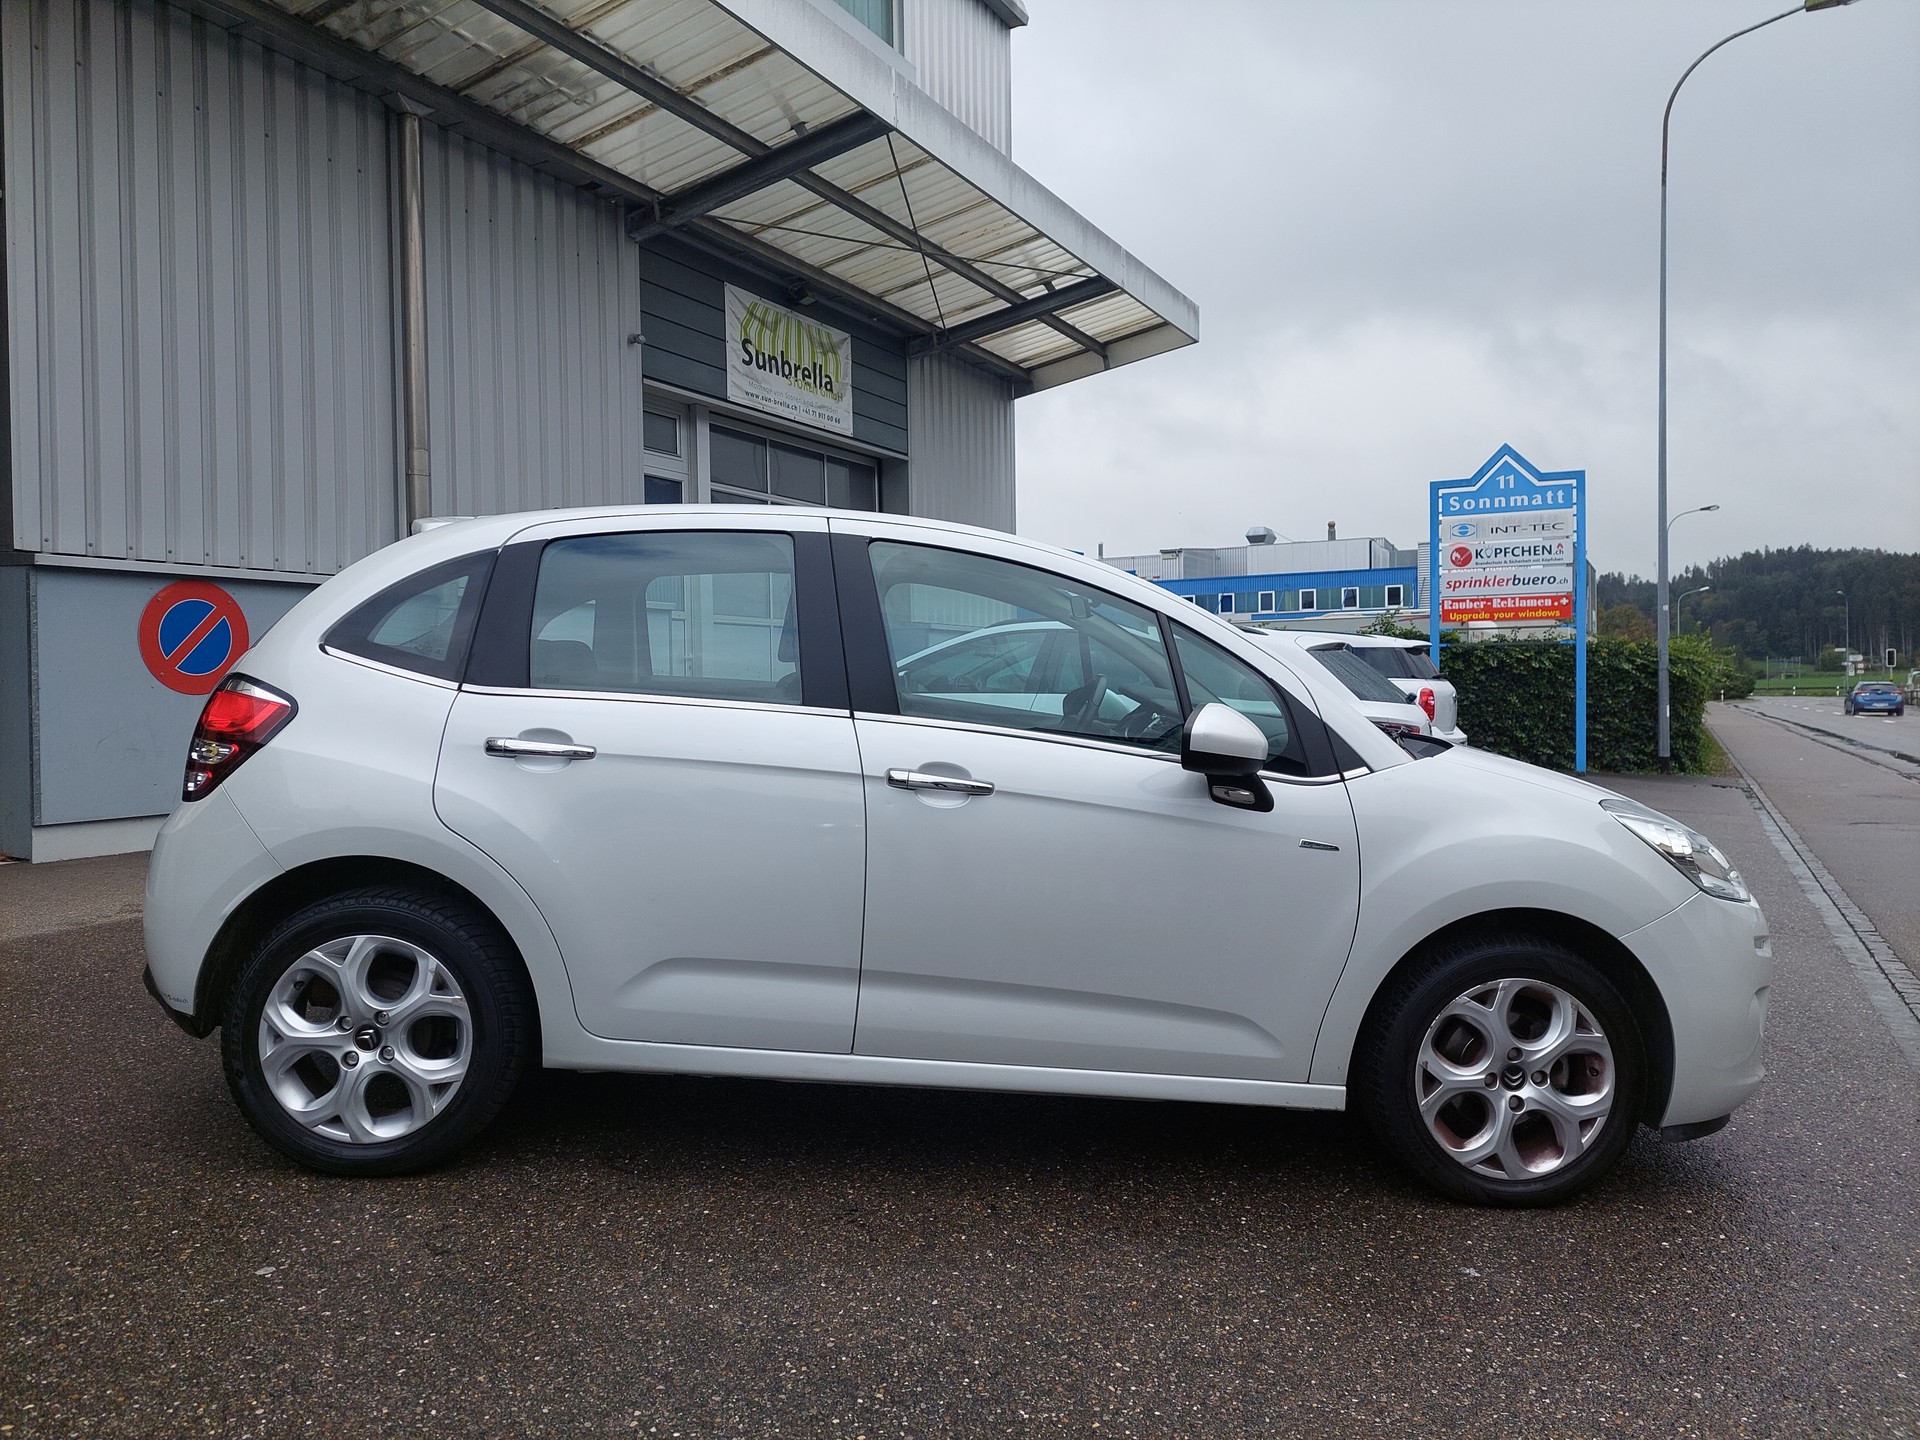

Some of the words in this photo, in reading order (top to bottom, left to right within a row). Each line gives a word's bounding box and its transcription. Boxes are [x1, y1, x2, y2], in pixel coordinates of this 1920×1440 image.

[742, 338, 834, 393] Sunbrella
[744, 389, 798, 411] www.sun-brella.ch
[1496, 474, 1515, 490] 11
[1449, 489, 1565, 511] Sonnmatt
[1490, 522, 1565, 534] INT-TEC
[1446, 574, 1569, 592] sprinklerbuero.ch
[1449, 612, 1490, 622] Upgrade
[1493, 611, 1515, 620] your
[1518, 609, 1561, 618] windows
